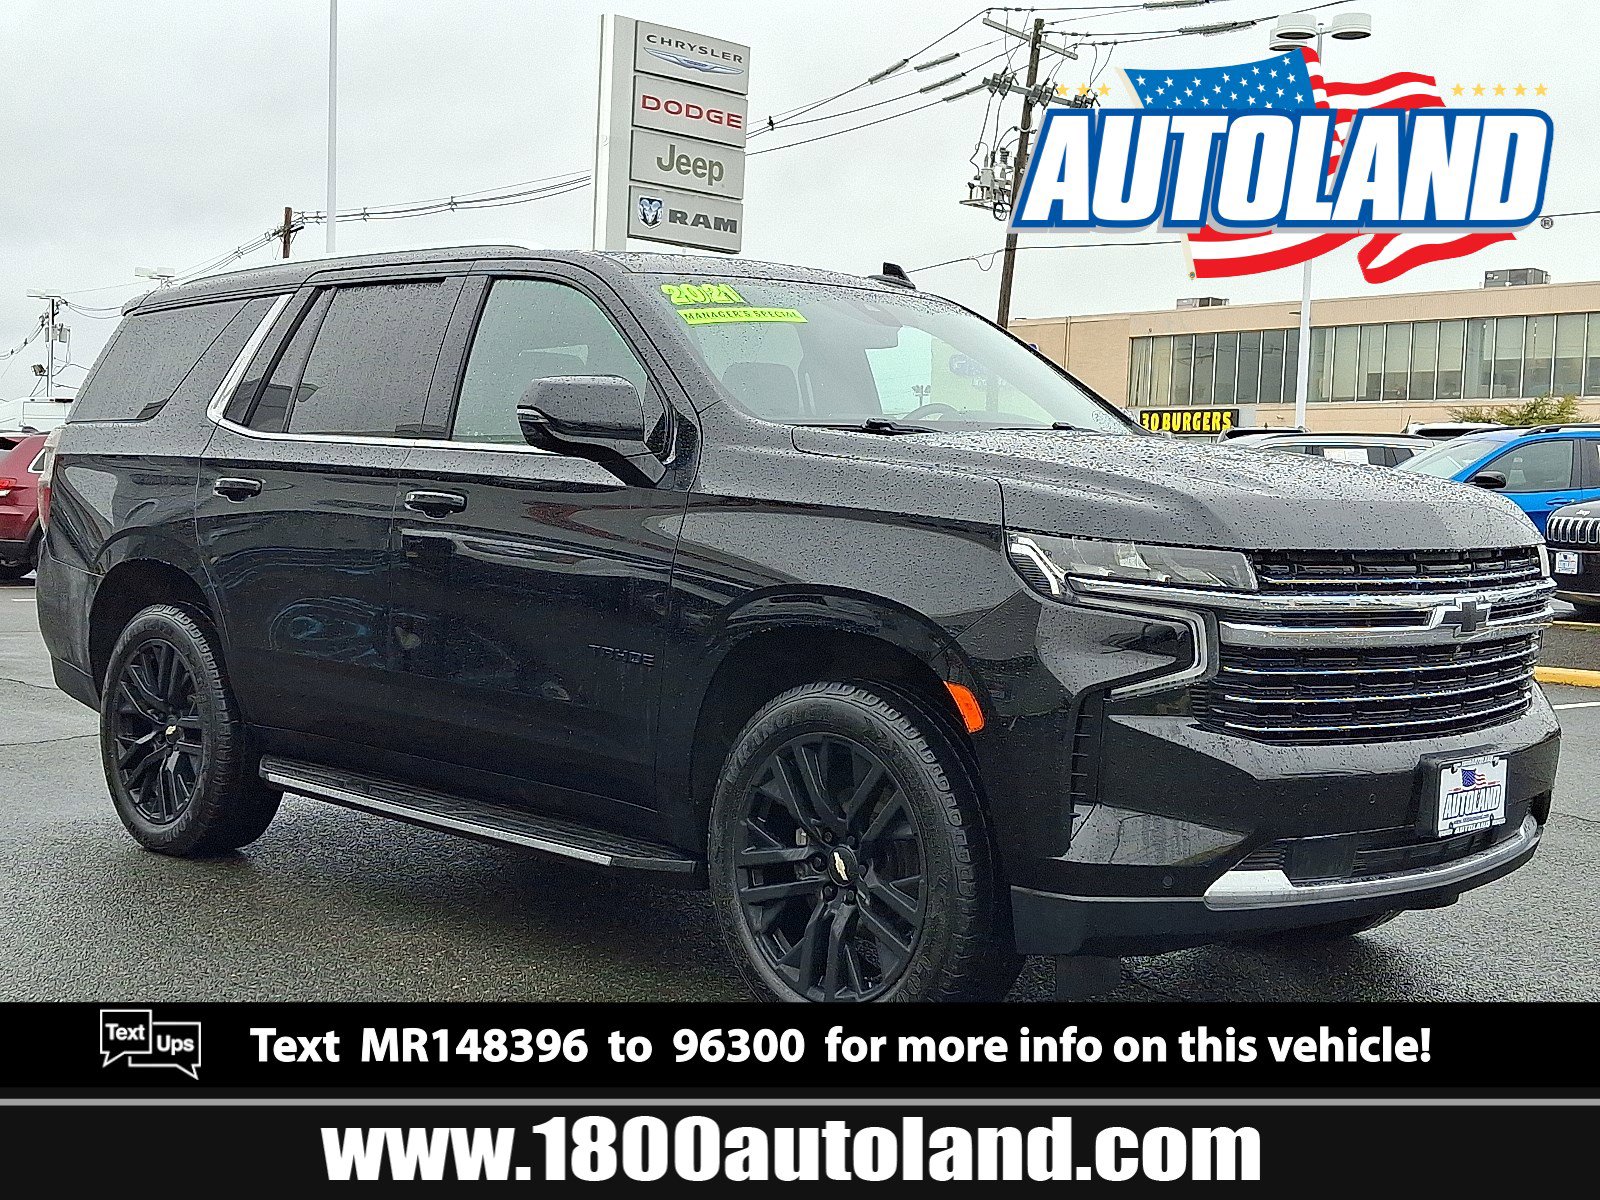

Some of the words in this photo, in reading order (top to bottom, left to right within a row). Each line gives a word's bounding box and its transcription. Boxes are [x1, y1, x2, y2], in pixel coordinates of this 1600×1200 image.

[646, 34, 743, 64] CHRYSLER
[641, 94, 743, 129] DODGE
[656, 143, 724, 186] Jeep
[668, 208, 738, 234] RAM
[660, 283, 746, 305] 2021
[684, 309, 751, 321] MANAGER'S
[755, 309, 802, 319] SPECIAL
[1162, 411, 1232, 431] BURGERS
[1443, 784, 1501, 820] AUTOLAND
